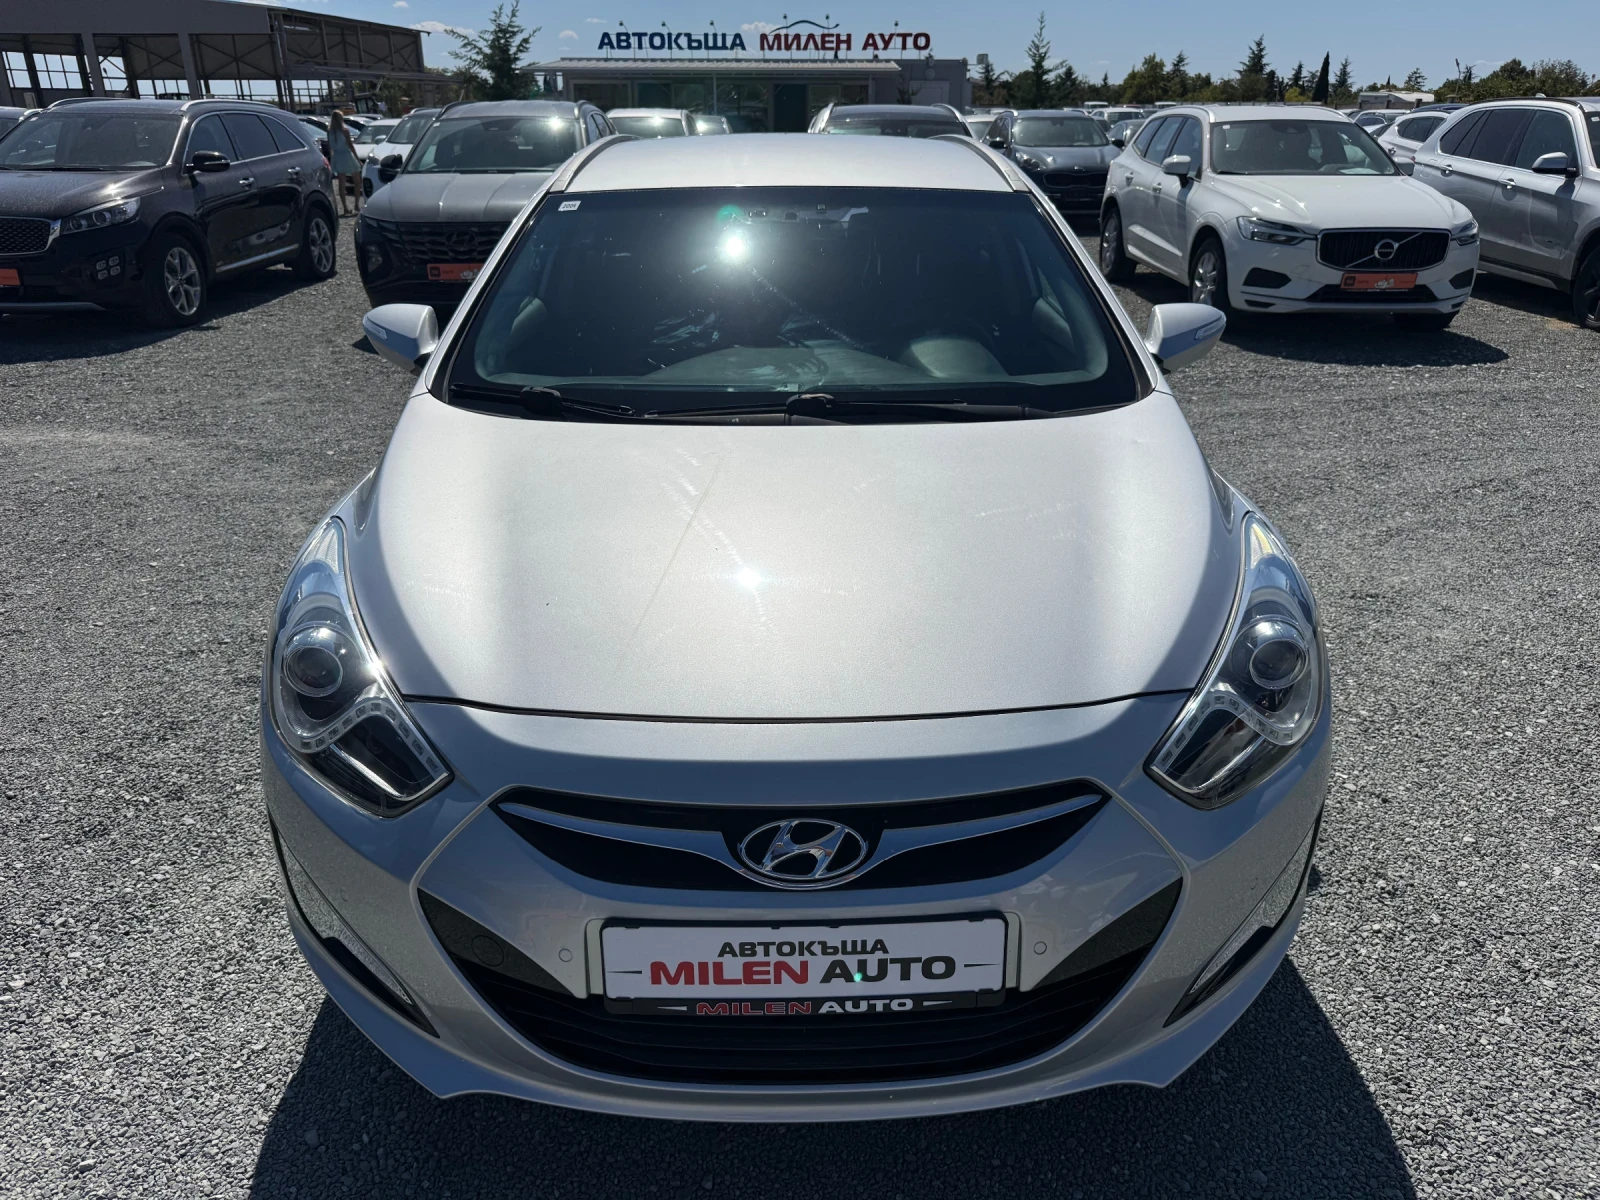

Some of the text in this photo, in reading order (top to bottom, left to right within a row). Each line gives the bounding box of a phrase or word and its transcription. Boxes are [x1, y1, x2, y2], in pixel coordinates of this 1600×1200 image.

[759, 33, 852, 51] МИЛЕН
[862, 32, 931, 51] АУТО
[650, 955, 956, 985] MILEN AUTO
[696, 998, 914, 1015] MILEN AUTO
